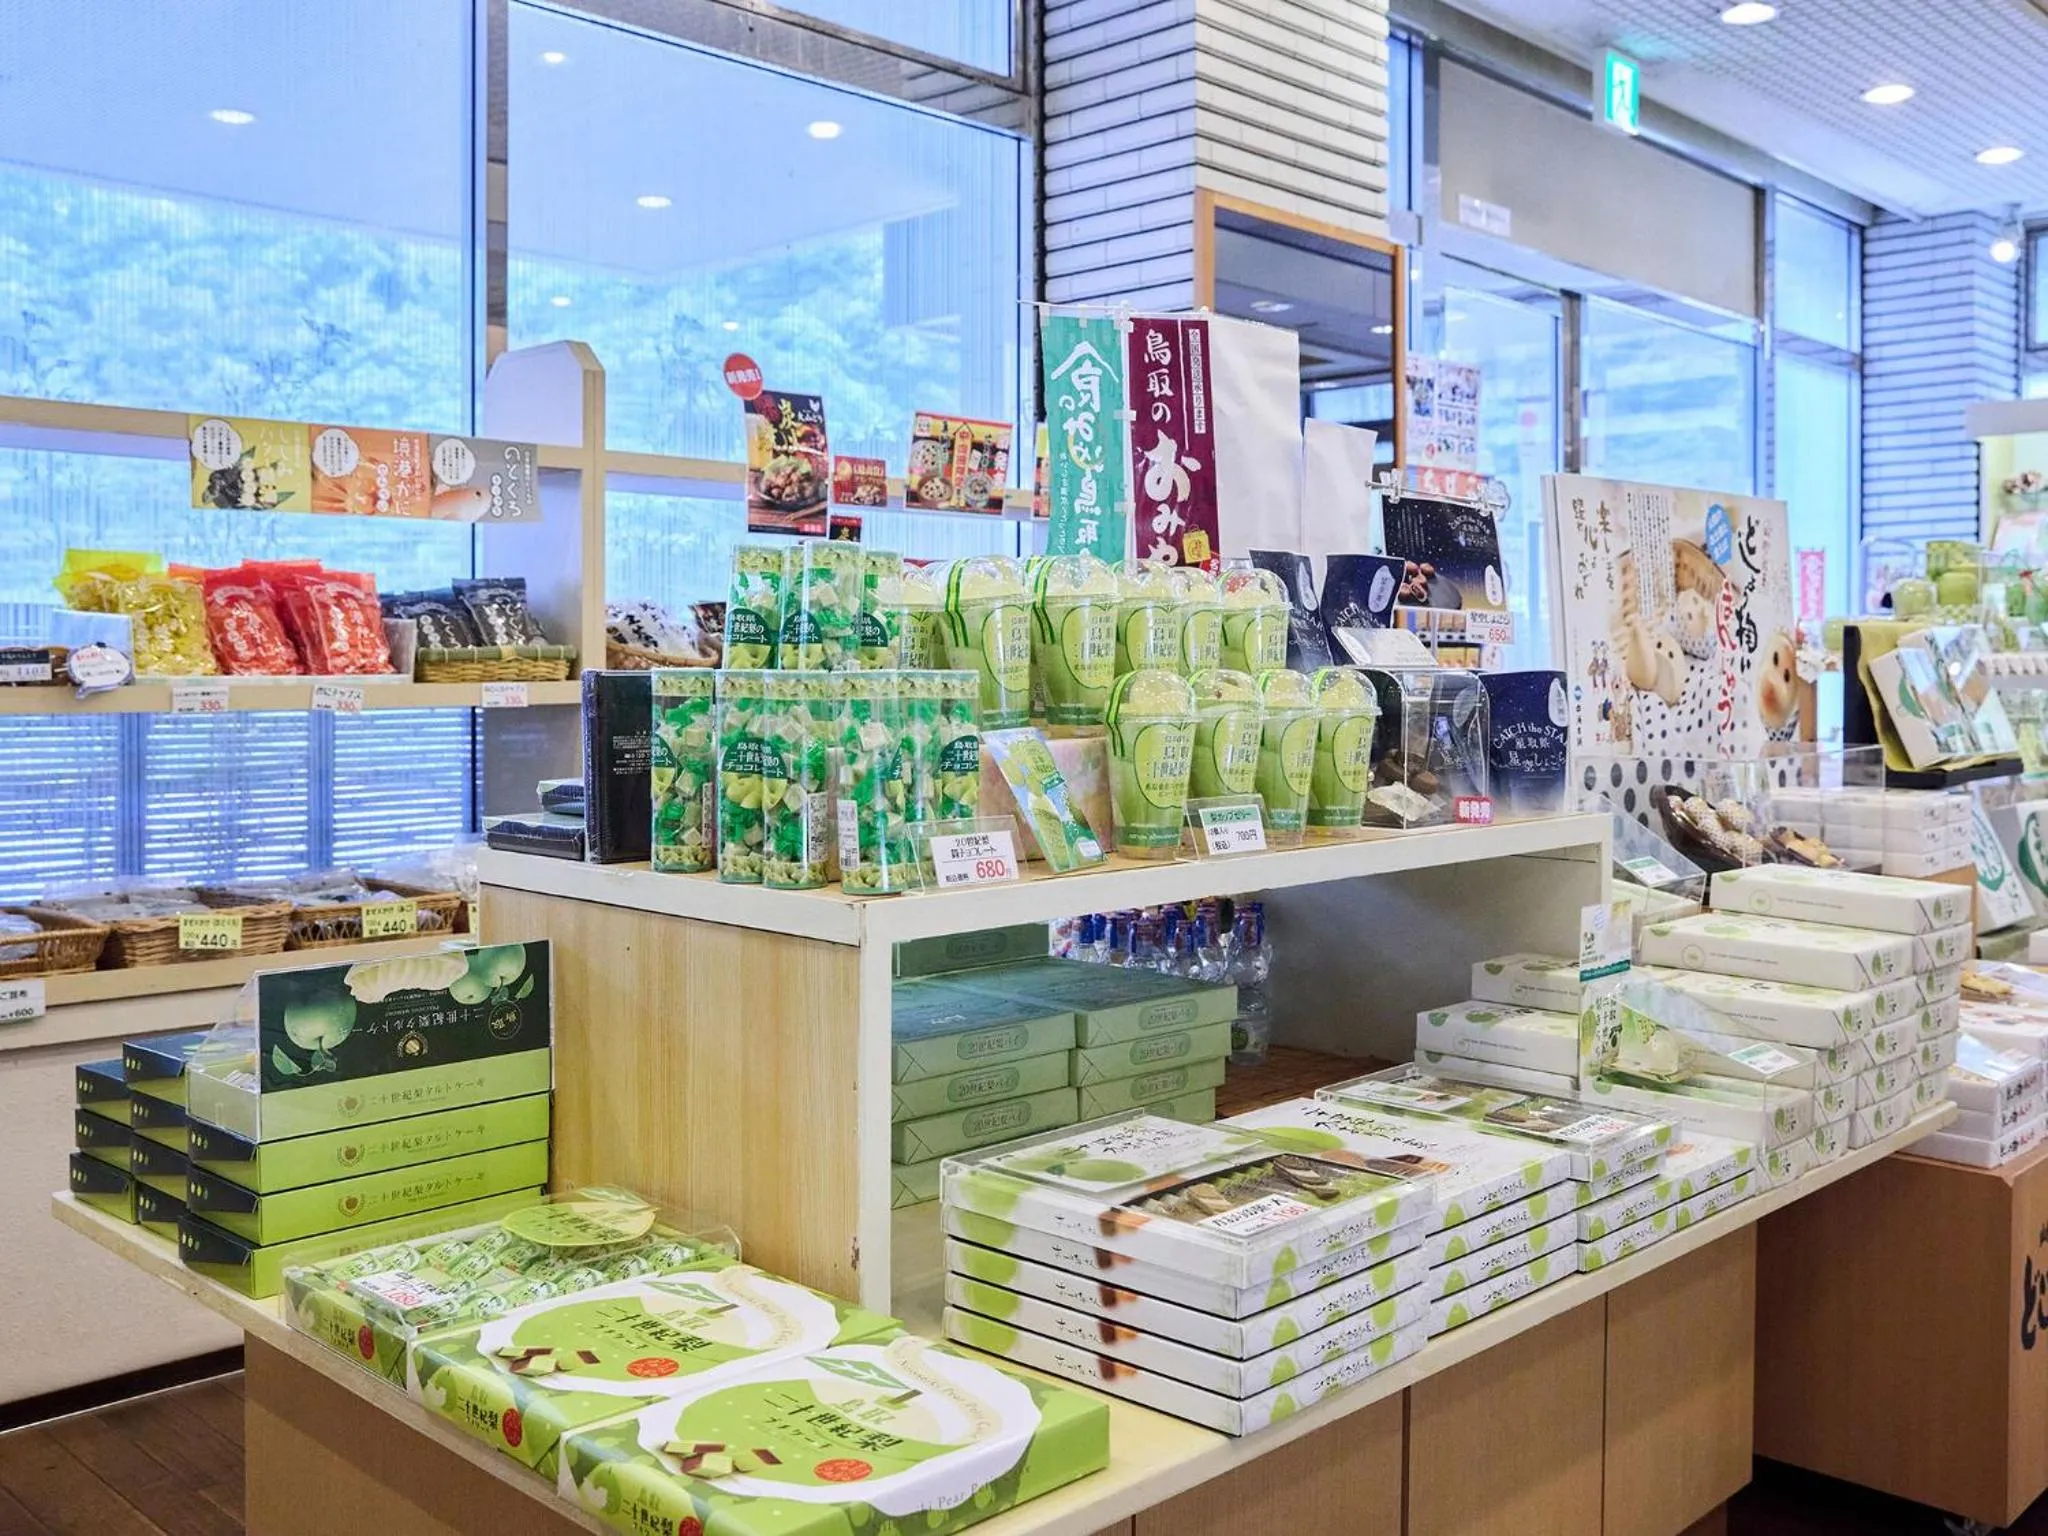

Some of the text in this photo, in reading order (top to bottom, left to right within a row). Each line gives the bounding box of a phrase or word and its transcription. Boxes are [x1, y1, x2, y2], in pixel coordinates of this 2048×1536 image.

[1493, 722, 1527, 749] CATCH
[595, 1306, 713, 1353] 二十世紀梨
[763, 1392, 905, 1453] 二十世紀梨
